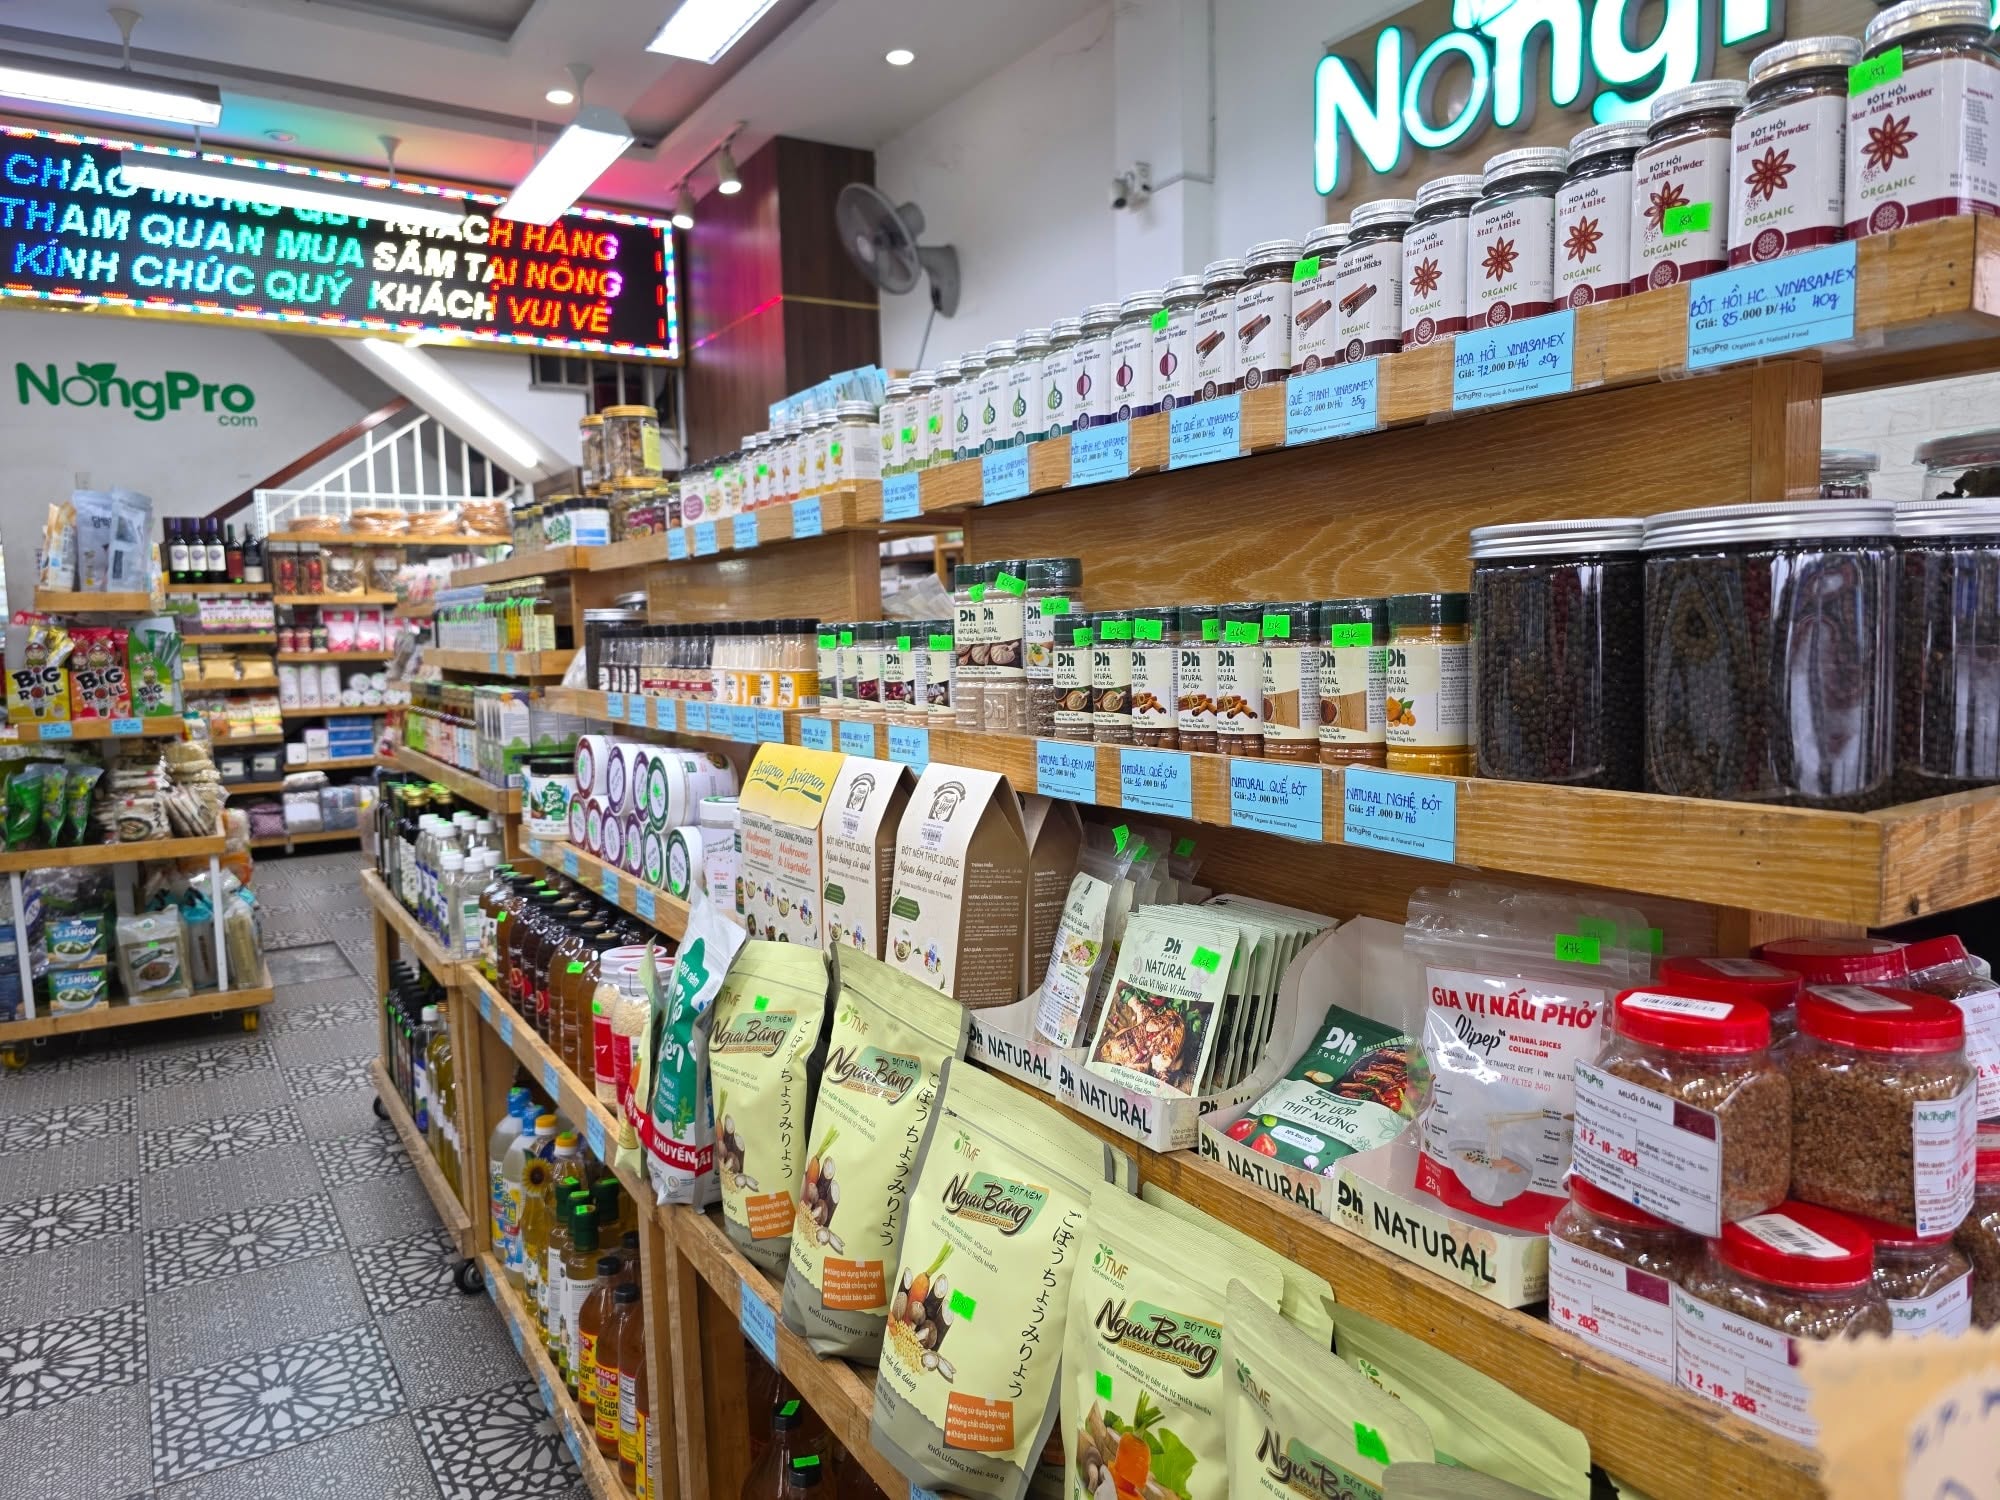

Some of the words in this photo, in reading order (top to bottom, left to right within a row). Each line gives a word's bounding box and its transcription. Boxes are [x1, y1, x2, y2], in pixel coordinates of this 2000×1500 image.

[1870, 99, 1895, 116] Anise
[1896, 86, 1934, 107] Powder
[1752, 133, 1774, 149] Anise
[1775, 122, 1811, 141] Powder
[1651, 169, 1671, 183] Anise
[1672, 158, 1705, 176] Powder
[1568, 191, 1584, 205] HOA
[1860, 175, 1917, 200] ORGANIC
[1559, 204, 1578, 218] Star
[1581, 195, 1606, 210] Anise
[1744, 205, 1795, 228] ORGANIC
[1476, 224, 1494, 238] Star
[1497, 216, 1521, 232] Anise
[1485, 215, 1500, 227] HOA
[0, 196, 131, 241] THAM
[140, 212, 265, 256] QUAN
[275, 229, 364, 268] MUA
[523, 258, 622, 298] NÔNG
[522, 221, 619, 260] HÀNG
[1413, 237, 1426, 247] HOA
[1423, 238, 1445, 252] Anise
[1643, 238, 1688, 259] ORGANIC
[14, 239, 120, 283] KÍNH
[132, 255, 256, 297] CHÚC
[265, 270, 352, 305] QUÝ
[367, 281, 499, 322] KHÁCH
[507, 295, 561, 328] VUI
[1562, 264, 1602, 281] ORGANIC
[1481, 282, 1518, 300] ORGANIC
[1748, 288, 1767, 304] HC
[1775, 265, 1857, 298] VINASAMEX
[1409, 299, 1442, 316] ORGANIC
[1695, 317, 1718, 331] Giá:
[1812, 292, 1841, 311] 40g
[1341, 321, 1371, 336] ORGANIC
[1731, 340, 1756, 351] Organic
[1766, 333, 1790, 345] Natural
[1791, 329, 1809, 340] Food
[1298, 338, 1327, 352] ORGANIC
[1456, 352, 1474, 368] HOA
[1507, 332, 1565, 357] VINASAMEX
[1241, 352, 1266, 365] ORGANIC
[1538, 352, 1560, 368] 20g
[1199, 366, 1221, 379] ORGANIC
[1231, 777, 1266, 792] NATURAL
[1291, 781, 1307, 801] BỘT
[1346, 788, 1383, 805] NATURAL
[1387, 792, 1416, 812] NGHỆ
[1421, 794, 1443, 815] BỘT
[1164, 936, 1182, 955] Dh
[1144, 959, 1187, 981] NATURAL
[1128, 974, 1138, 985] Bột
[1138, 976, 1149, 988] Gia
[1149, 979, 1156, 991] Vị
[1169, 983, 1178, 995] Vị
[1177, 986, 1203, 1001] Hương
[1432, 986, 1463, 1011] GIA
[1465, 991, 1486, 1019] VỊ
[1490, 988, 1537, 1021] NẤU
[1541, 1000, 1598, 1029] PHỞ
[851, 1015, 869, 1036] TMF
[1455, 1014, 1501, 1056] Vipep
[1320, 1026, 1358, 1057] Dh
[1508, 1045, 1549, 1059] COLLECTION
[1509, 1034, 1538, 1047] NATURAL
[1539, 1039, 1562, 1051] SPICES
[988, 1035, 1052, 1082] NATURAL
[1315, 1047, 1349, 1065] Foods
[1060, 1063, 1075, 1092] Dh
[1079, 1078, 1153, 1134] NATURAL
[1301, 1092, 1332, 1111] SỐT
[1618, 1088, 1639, 1102] MUỐI
[1647, 1099, 1662, 1112] MAI
[653, 1134, 697, 1165] KHUYẾN
[961, 1140, 981, 1161] TMF
[1202, 1132, 1220, 1163] Dh
[1617, 1146, 1639, 1168] 2025
[942, 1171, 984, 1216] Ngưu
[1009, 1184, 1024, 1196] BỘT
[1025, 1189, 1043, 1202] NÊM
[1227, 1150, 1324, 1217] NATURAL
[1425, 1175, 1436, 1190] 25
[1338, 1180, 1364, 1215] Dh
[1336, 1203, 1365, 1226] Foods
[1051, 1209, 1083, 1265] ごぼう
[1373, 1200, 1498, 1284] NATURAL
[1105, 1255, 1129, 1281] TMF
[1571, 1255, 1591, 1270] MUỐI
[1600, 1267, 1615, 1278] MAI
[1110, 1277, 1125, 1292] FOODS
[1094, 1297, 1154, 1346] Ngưu
[1184, 1320, 1203, 1333] BỘT
[1577, 1312, 1599, 1334] 2025
[1722, 1322, 1745, 1337] MUỐI
[1756, 1335, 1774, 1349] MAI
[1155, 1348, 1201, 1372] SEASONING
[1732, 1390, 1758, 1414] 2025
[928, 1442, 942, 1458] KHỐI
[985, 1471, 999, 1480] 450
[999, 1475, 1005, 1484] g
